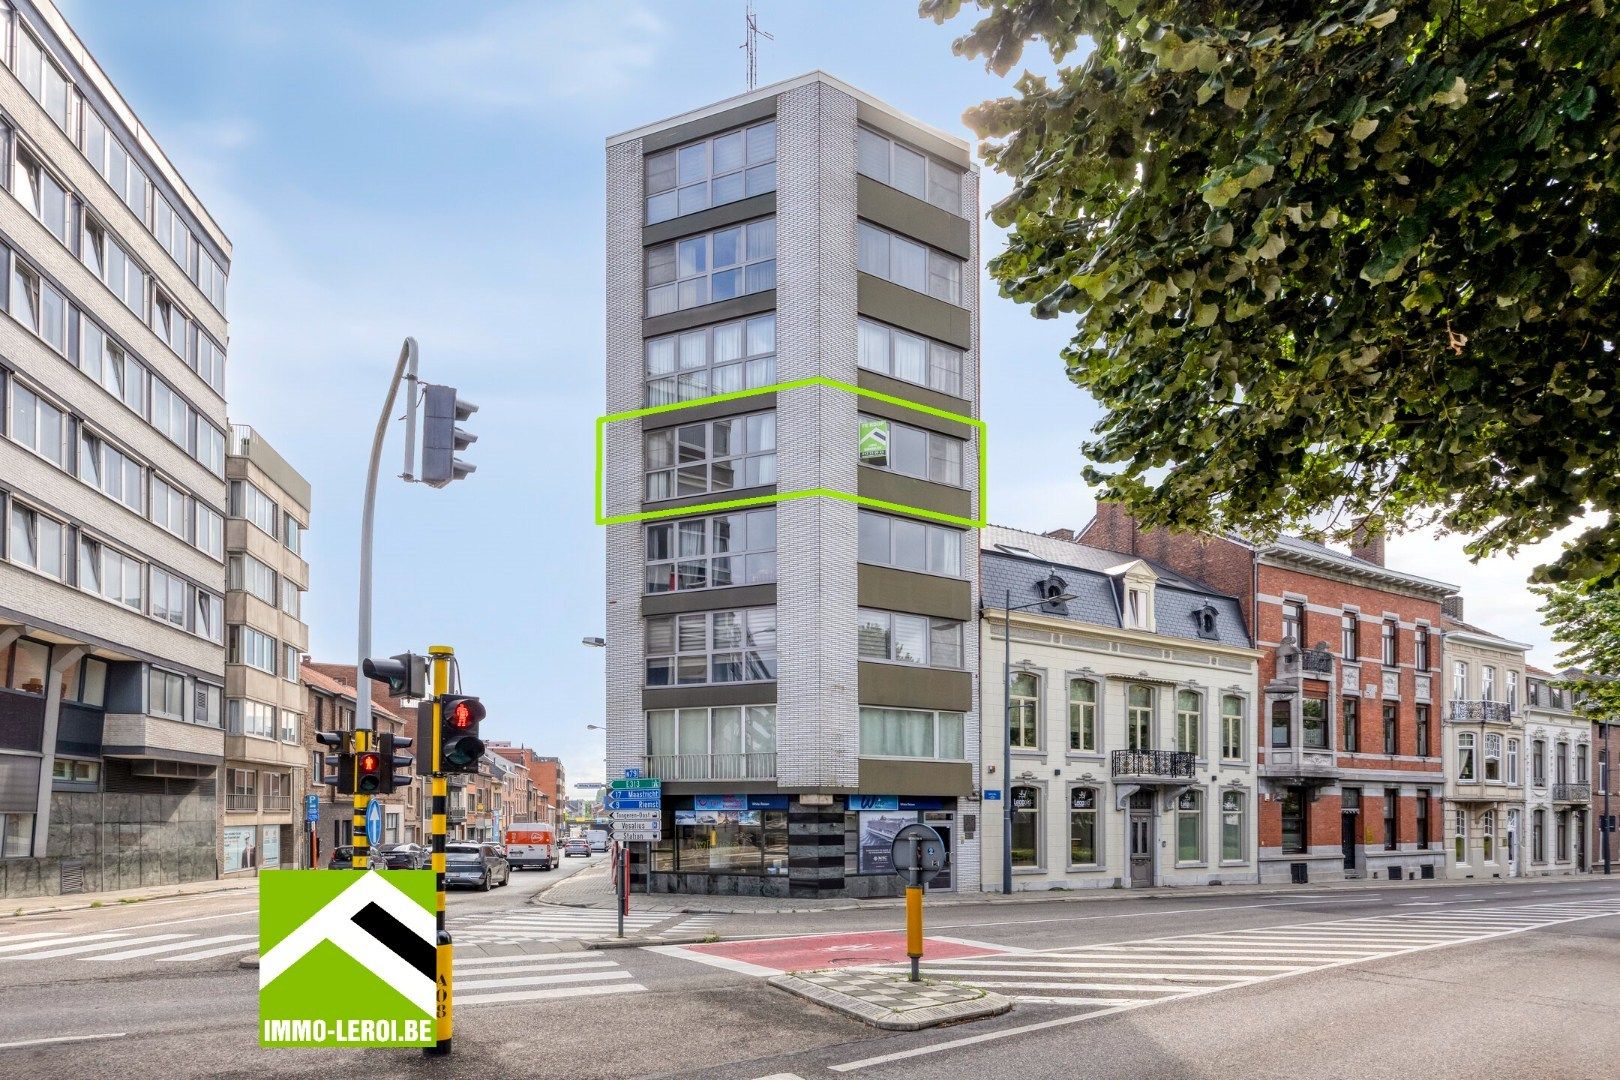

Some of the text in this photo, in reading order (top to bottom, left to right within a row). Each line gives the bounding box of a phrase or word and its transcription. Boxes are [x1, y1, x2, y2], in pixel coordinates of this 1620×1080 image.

[309, 795, 316, 804] P
[615, 800, 659, 809] 9 Riemst
[621, 822, 645, 830] Vesalius
[623, 832, 644, 840] Station
